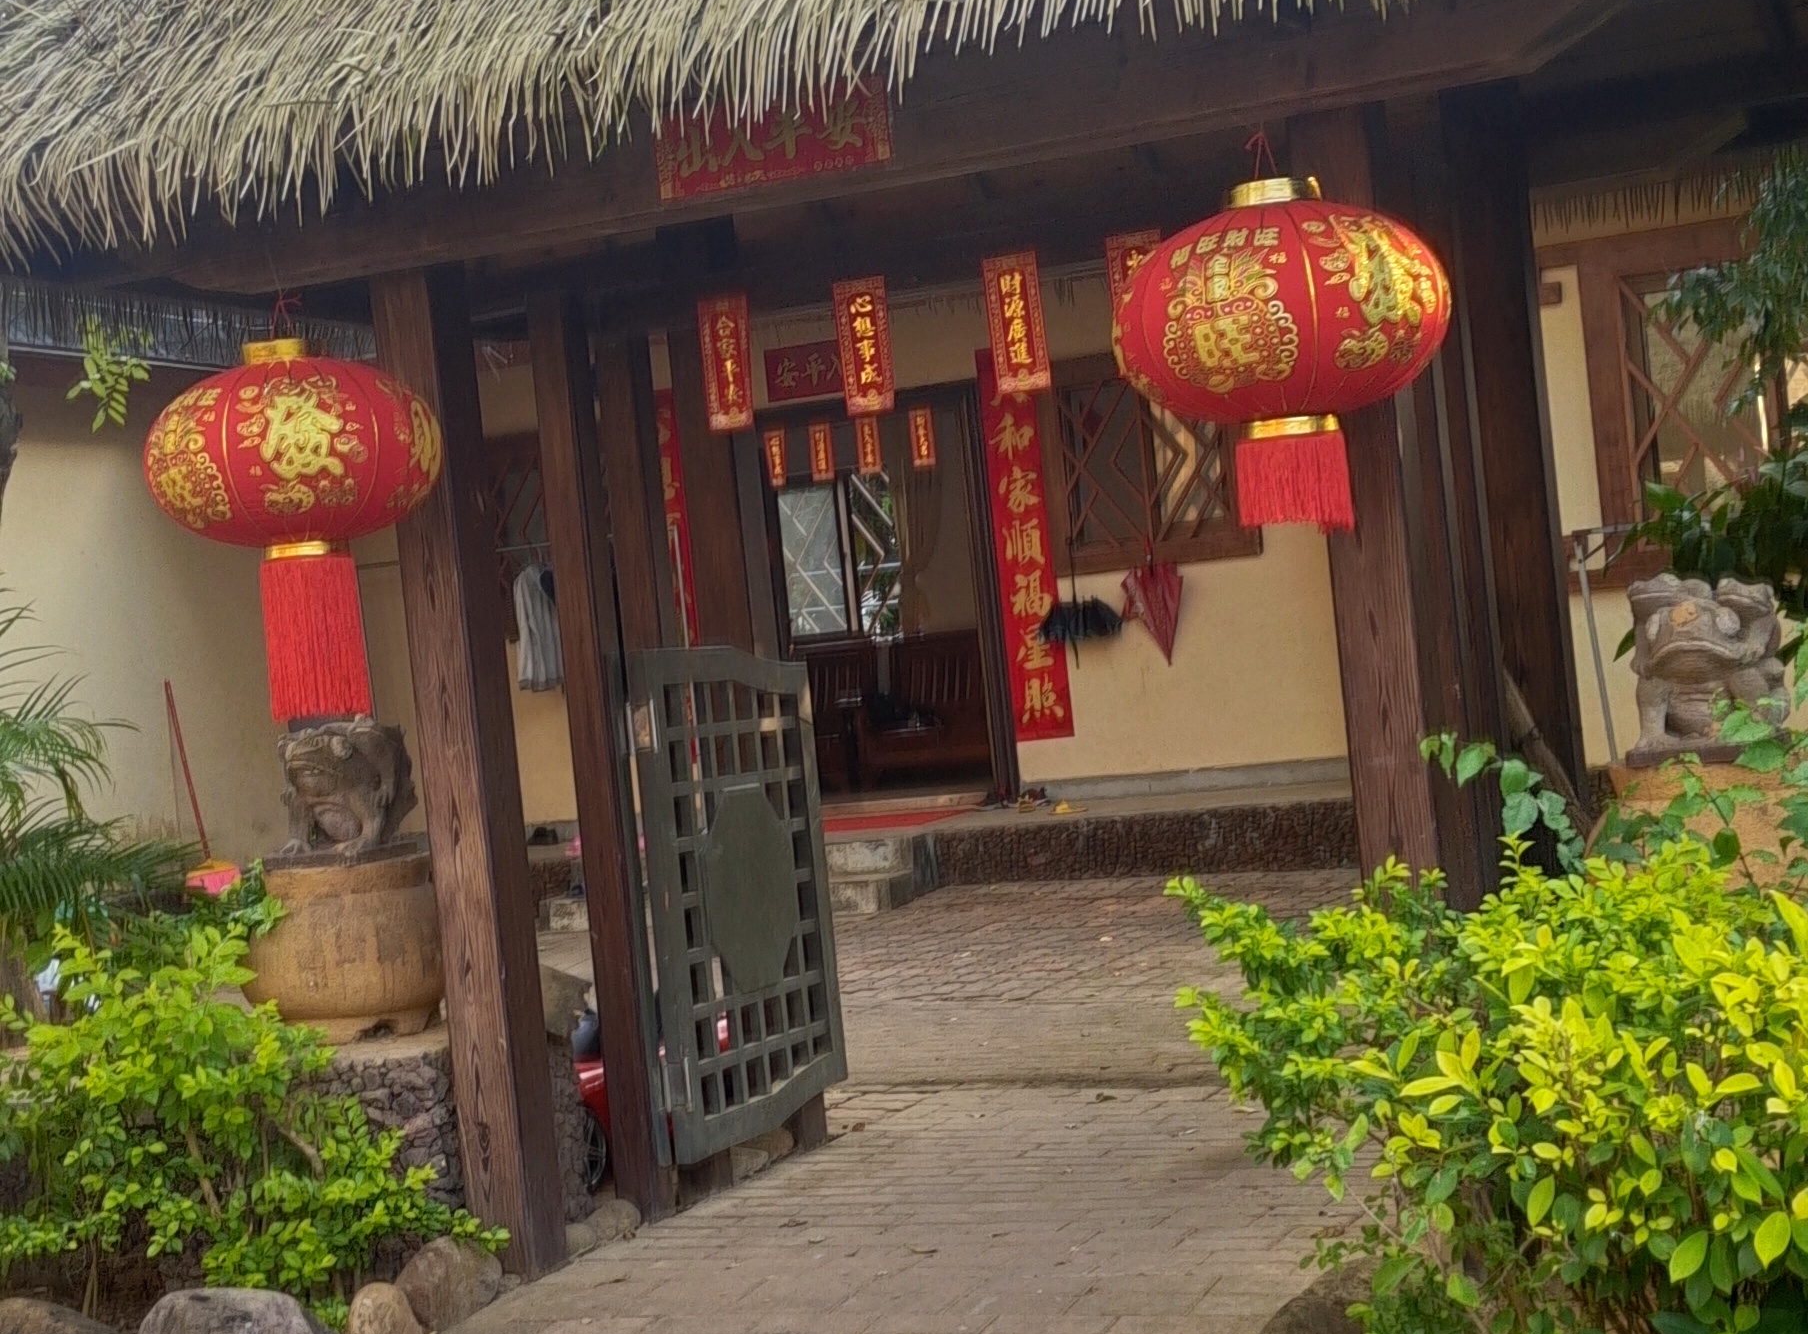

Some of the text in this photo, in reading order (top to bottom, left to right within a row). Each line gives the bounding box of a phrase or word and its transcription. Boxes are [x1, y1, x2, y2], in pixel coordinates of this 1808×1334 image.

[716, 314, 743, 405] 合家平安
[850, 294, 883, 385] 心想事成
[1194, 315, 1260, 368] 旺
[260, 391, 345, 479] 發
[989, 393, 1064, 724] 和家順福星照
